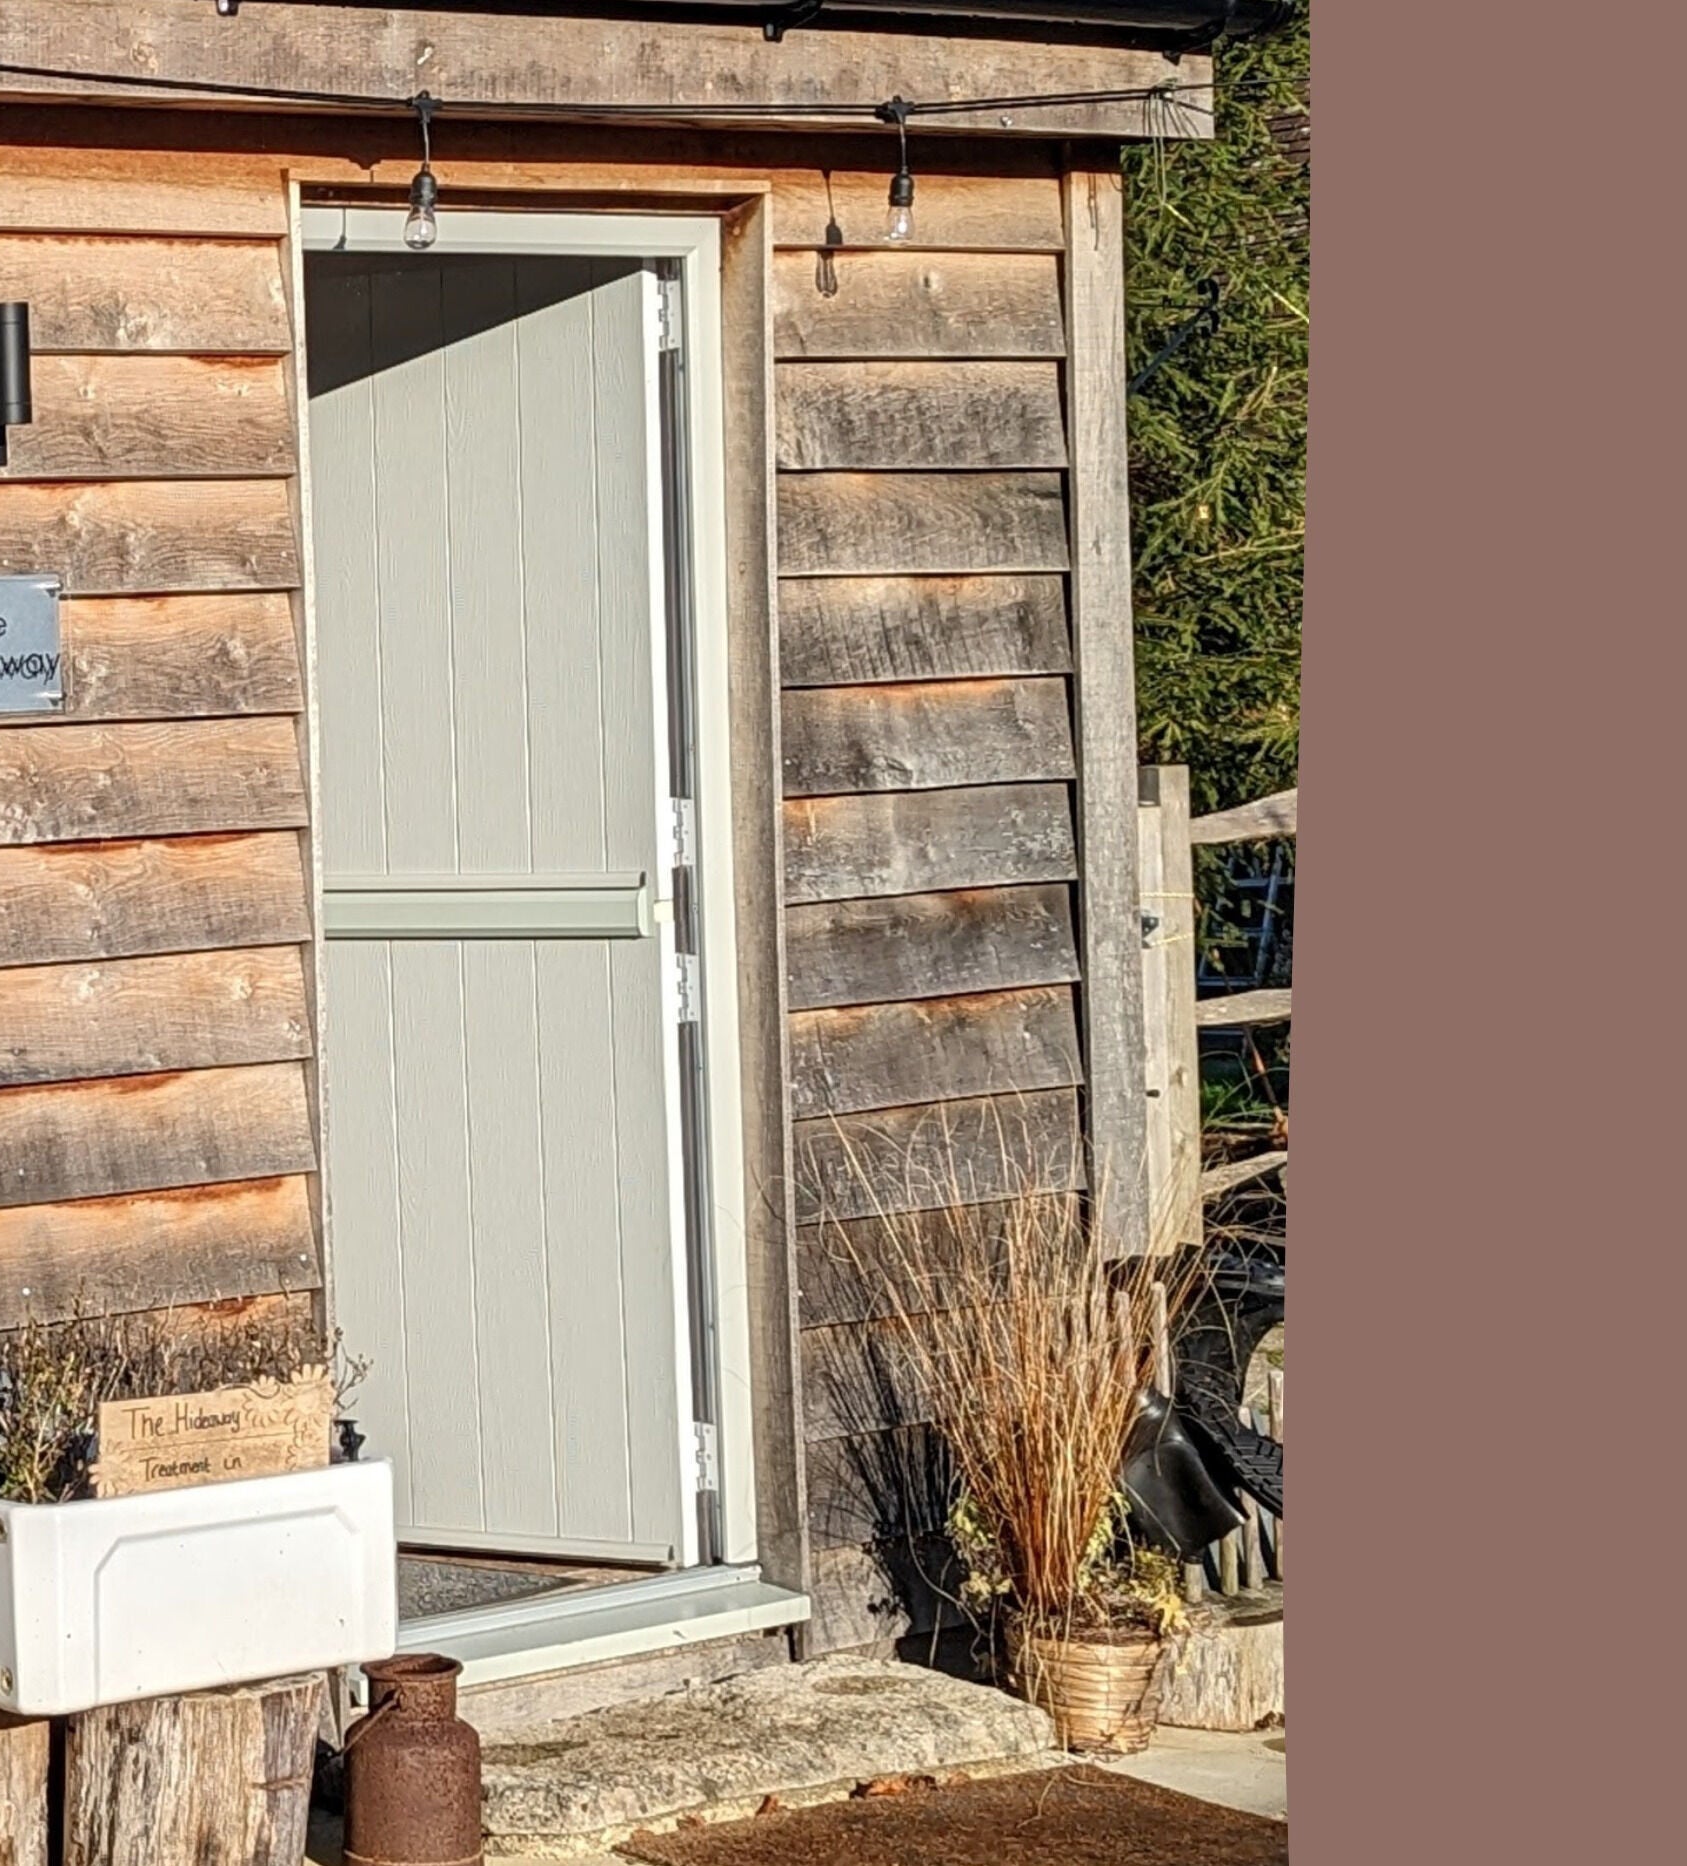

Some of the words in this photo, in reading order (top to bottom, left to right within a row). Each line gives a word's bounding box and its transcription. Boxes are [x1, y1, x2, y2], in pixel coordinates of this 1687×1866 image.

[122, 1405, 163, 1440] The
[168, 1402, 240, 1435] Hideaway
[139, 1456, 211, 1482] Treatment
[223, 1455, 242, 1471] in
